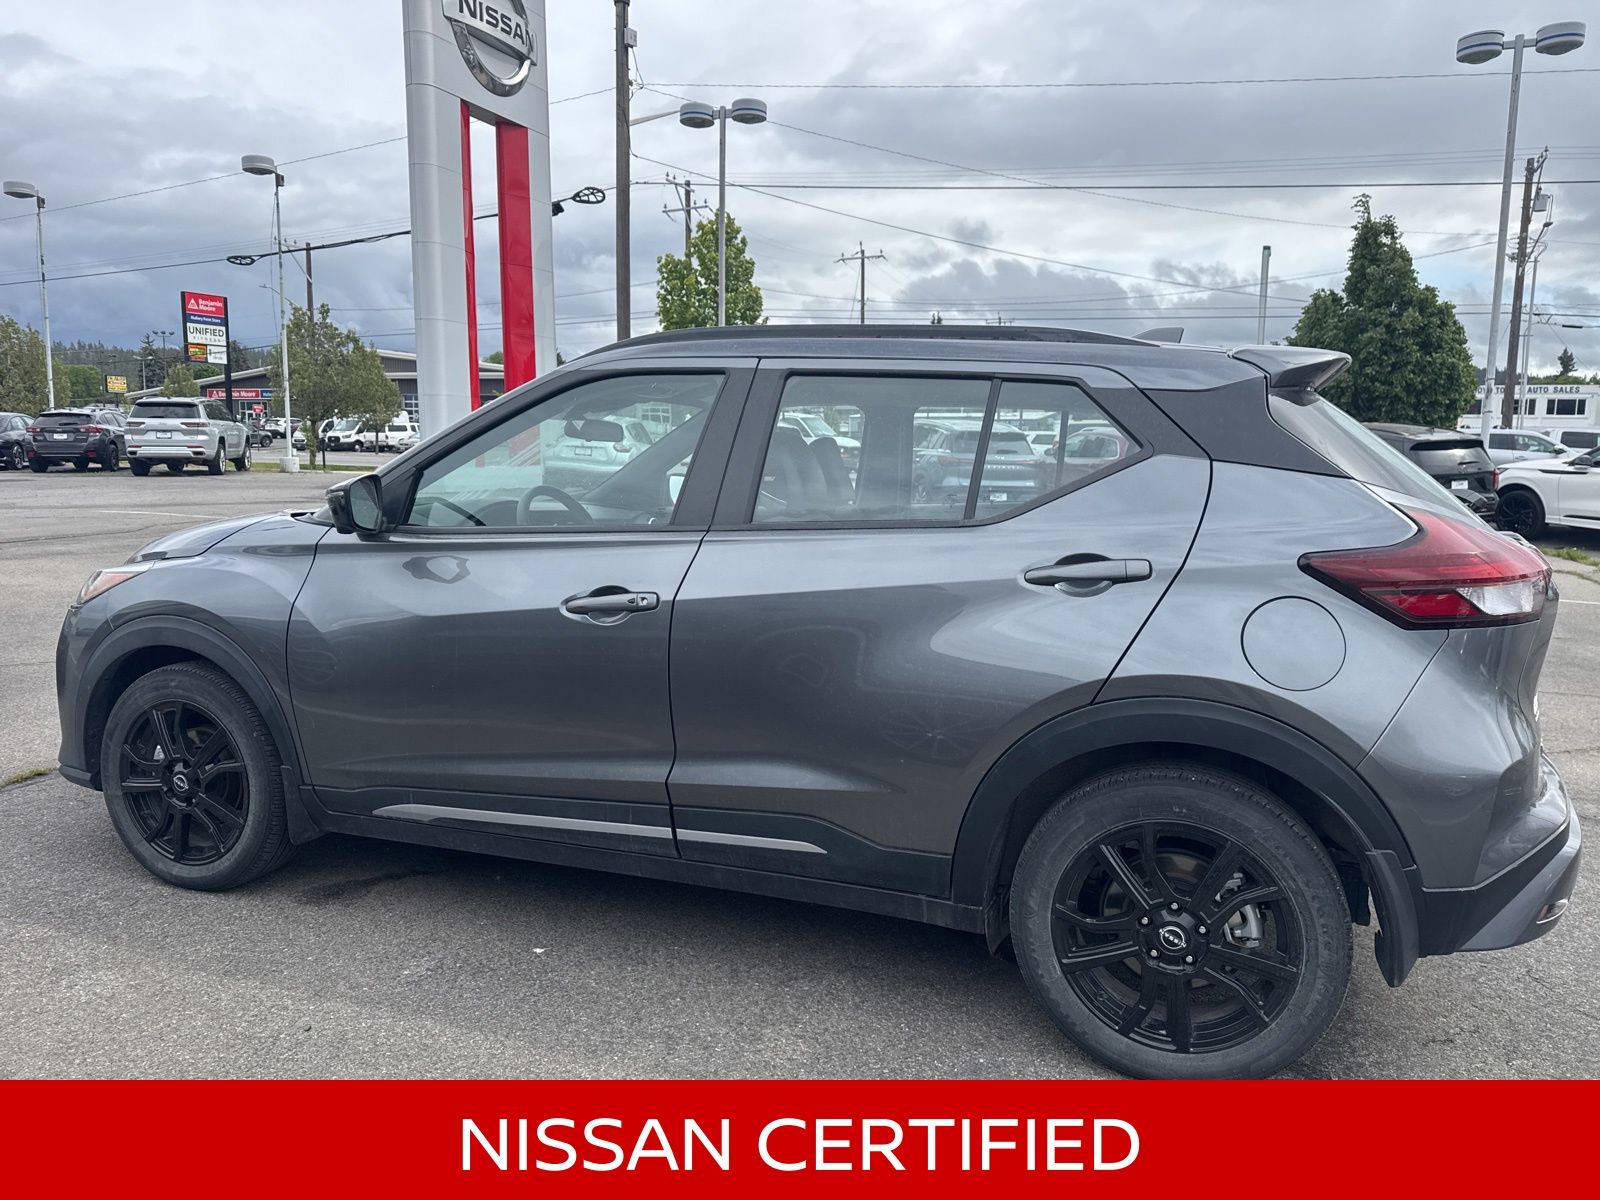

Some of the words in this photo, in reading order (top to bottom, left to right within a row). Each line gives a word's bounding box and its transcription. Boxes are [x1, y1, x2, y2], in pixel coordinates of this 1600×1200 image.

[458, 0, 534, 53] NISSAN
[198, 298, 223, 307] Benjamin
[198, 304, 216, 312] Moore
[188, 326, 225, 337] UNIFIED
[1527, 386, 1549, 394] AUTO
[1553, 386, 1581, 394] SALES
